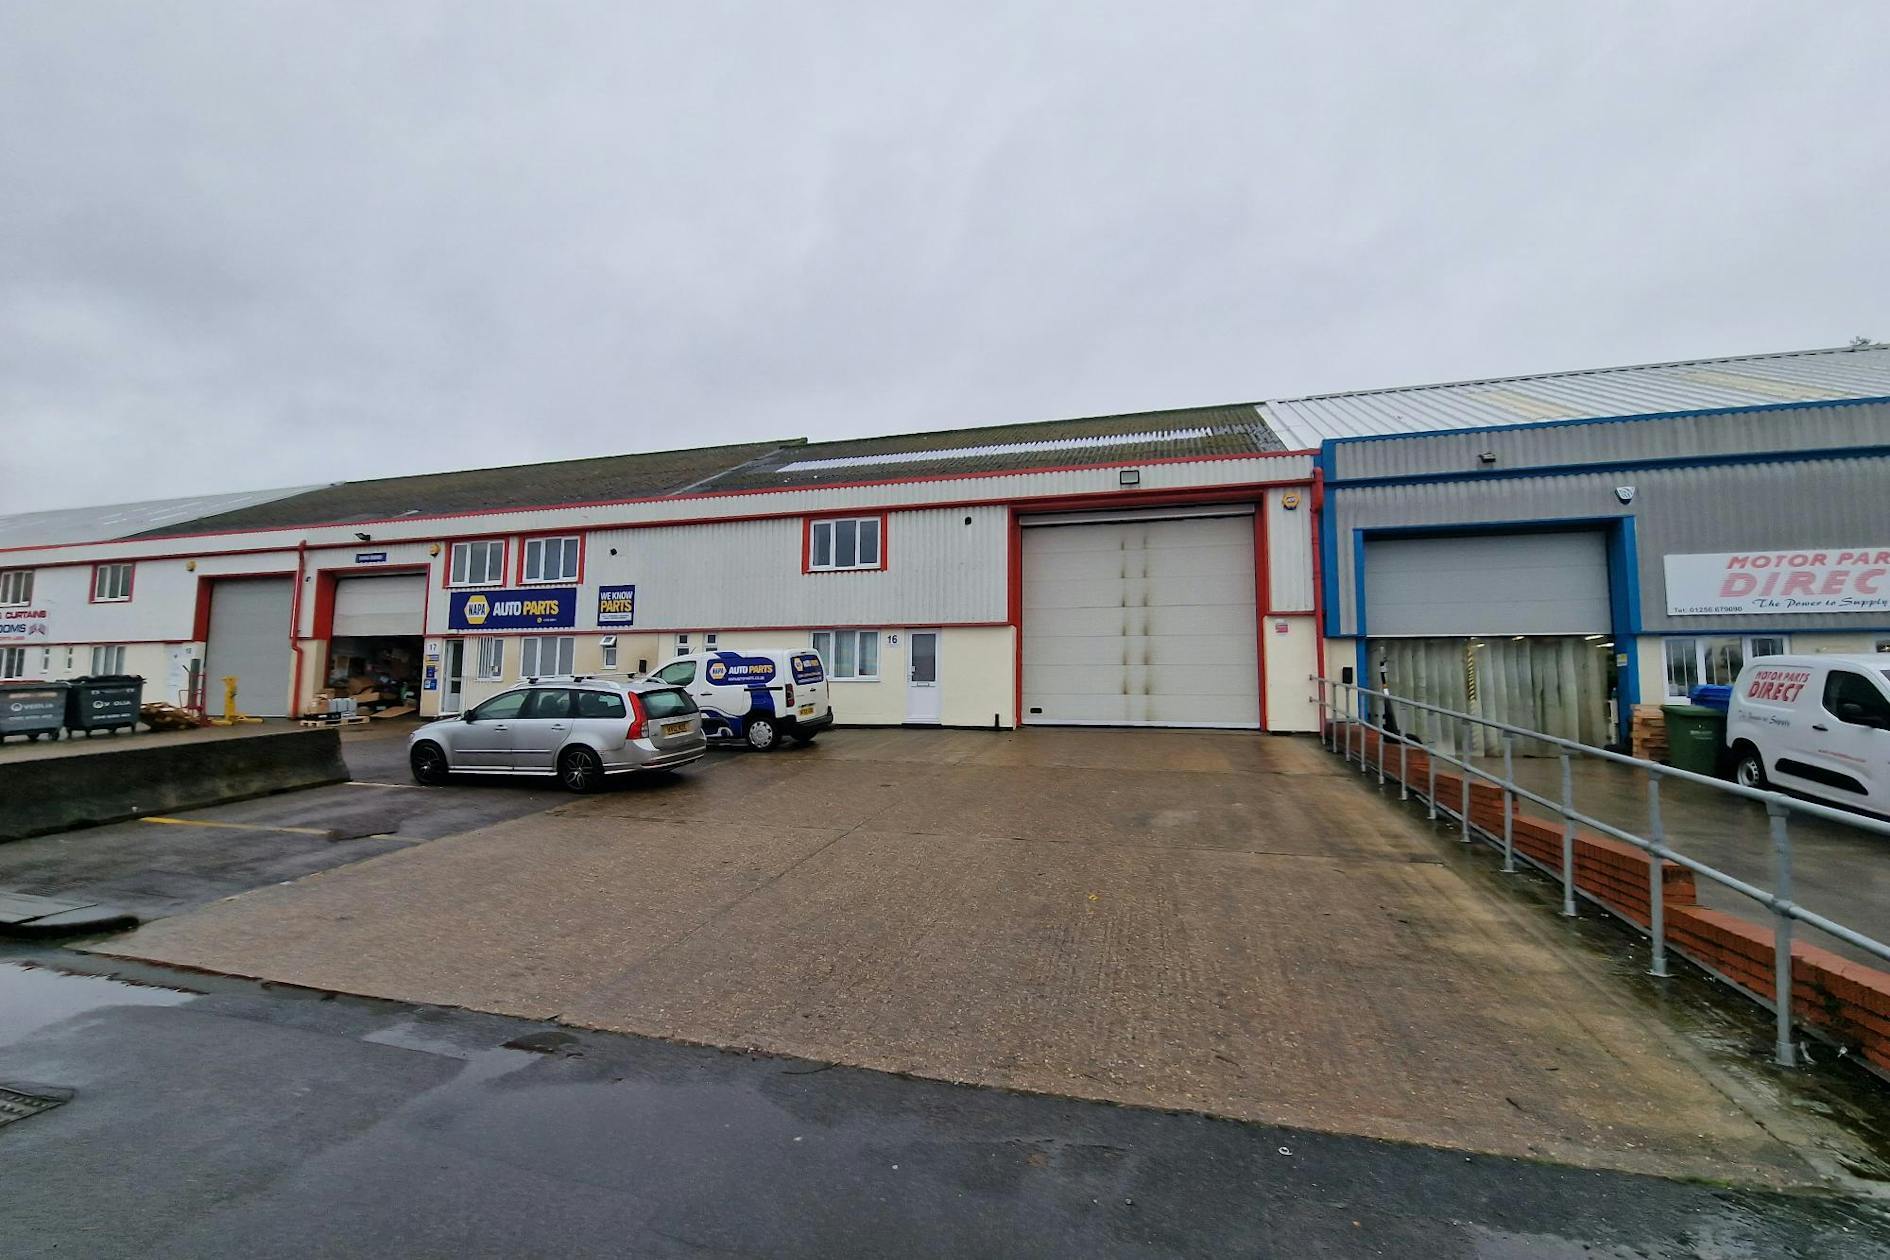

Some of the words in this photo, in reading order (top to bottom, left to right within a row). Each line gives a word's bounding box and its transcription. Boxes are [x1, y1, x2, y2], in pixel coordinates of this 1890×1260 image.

[1728, 554, 1827, 569] MOTOR
[1836, 551, 1890, 565] PAR
[1719, 569, 1887, 598] DIREC
[600, 591, 611, 600] WE
[612, 591, 633, 600] KNOW
[468, 603, 486, 616] NAPA
[493, 601, 521, 616] AUTO
[523, 600, 559, 615] PARTS
[600, 600, 632, 613] PARTS
[1752, 598, 1780, 608] The
[1785, 598, 1822, 608] Power
[1839, 597, 1888, 608] Supply
[6, 610, 47, 619] CURTAINS
[887, 634, 898, 644] 16
[430, 643, 437, 651] 17
[728, 665, 748, 675] AUTO
[748, 664, 774, 674] PARTS
[1754, 671, 1784, 681] MOTOR
[1783, 672, 1811, 683] PARTS
[1747, 681, 1805, 702] DIRECT
